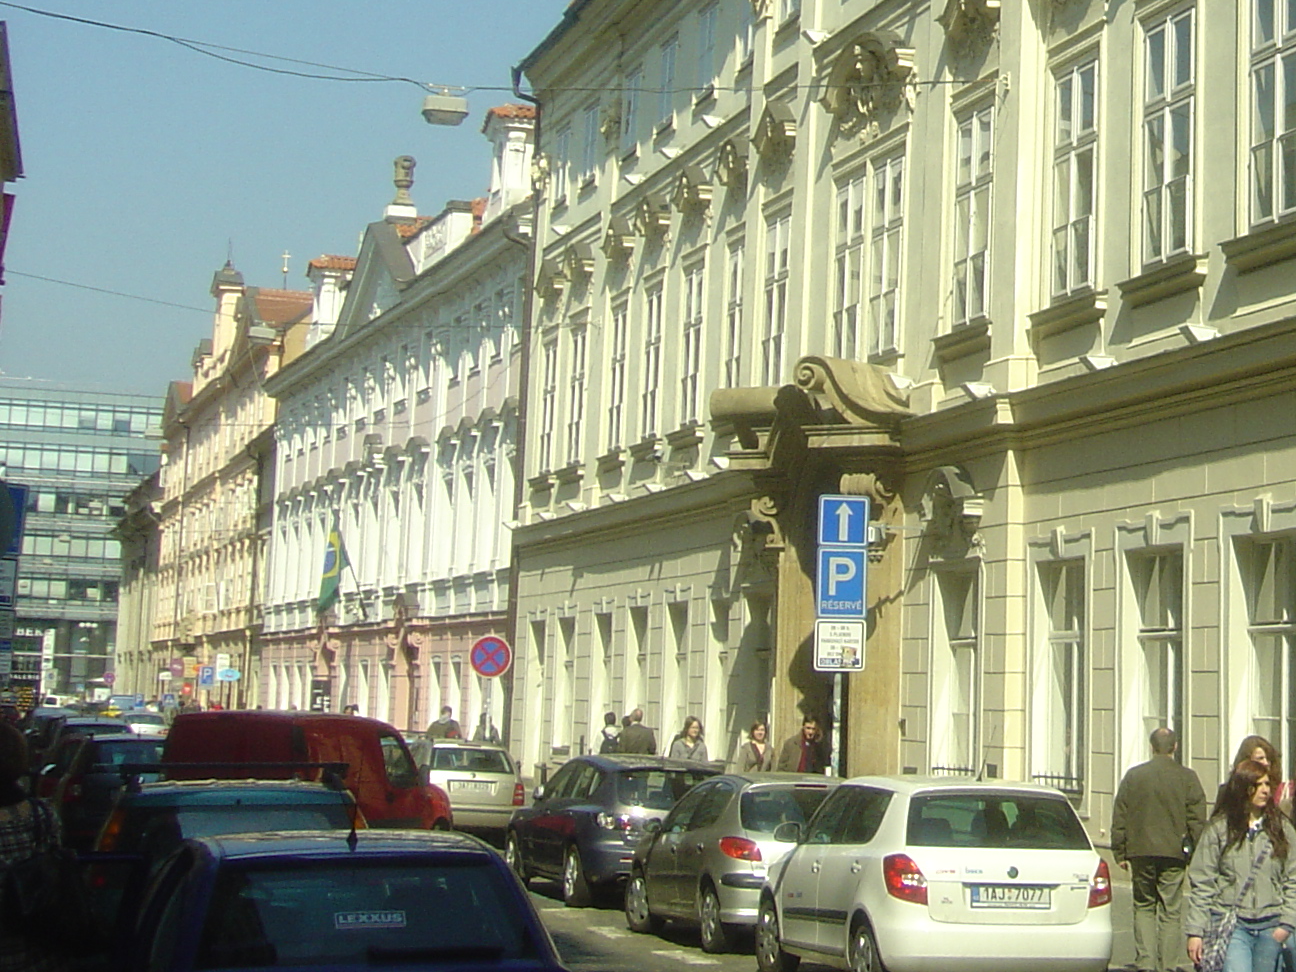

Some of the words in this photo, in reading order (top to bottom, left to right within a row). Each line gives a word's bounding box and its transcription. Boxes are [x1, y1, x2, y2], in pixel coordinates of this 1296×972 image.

[829, 557, 856, 596] P
[821, 599, 862, 610] RÉSERVÉ
[1014, 888, 1045, 902] 7077
[339, 913, 402, 924] LEXXUS
